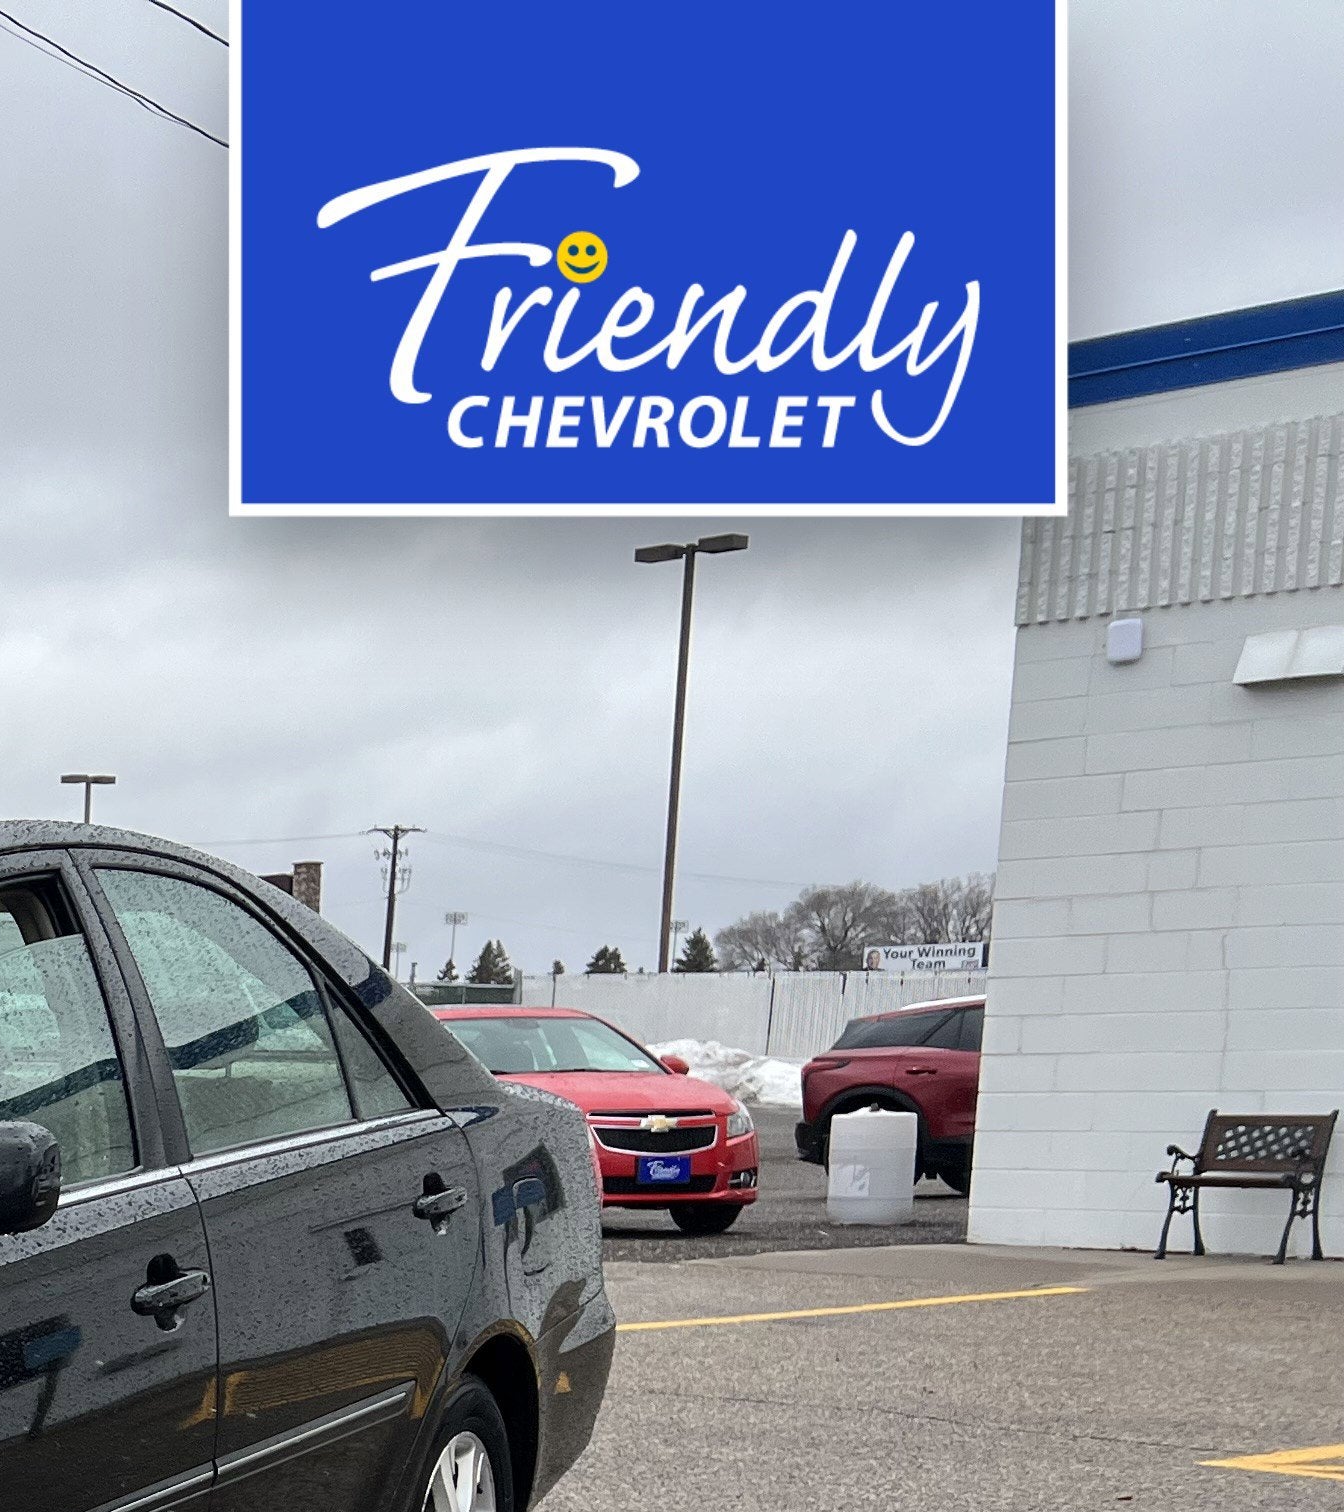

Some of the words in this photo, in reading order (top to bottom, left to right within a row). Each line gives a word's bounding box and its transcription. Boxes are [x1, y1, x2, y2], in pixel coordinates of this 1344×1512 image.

[883, 947, 913, 960] Your
[917, 944, 976, 958] Winning
[911, 958, 946, 971] Team
